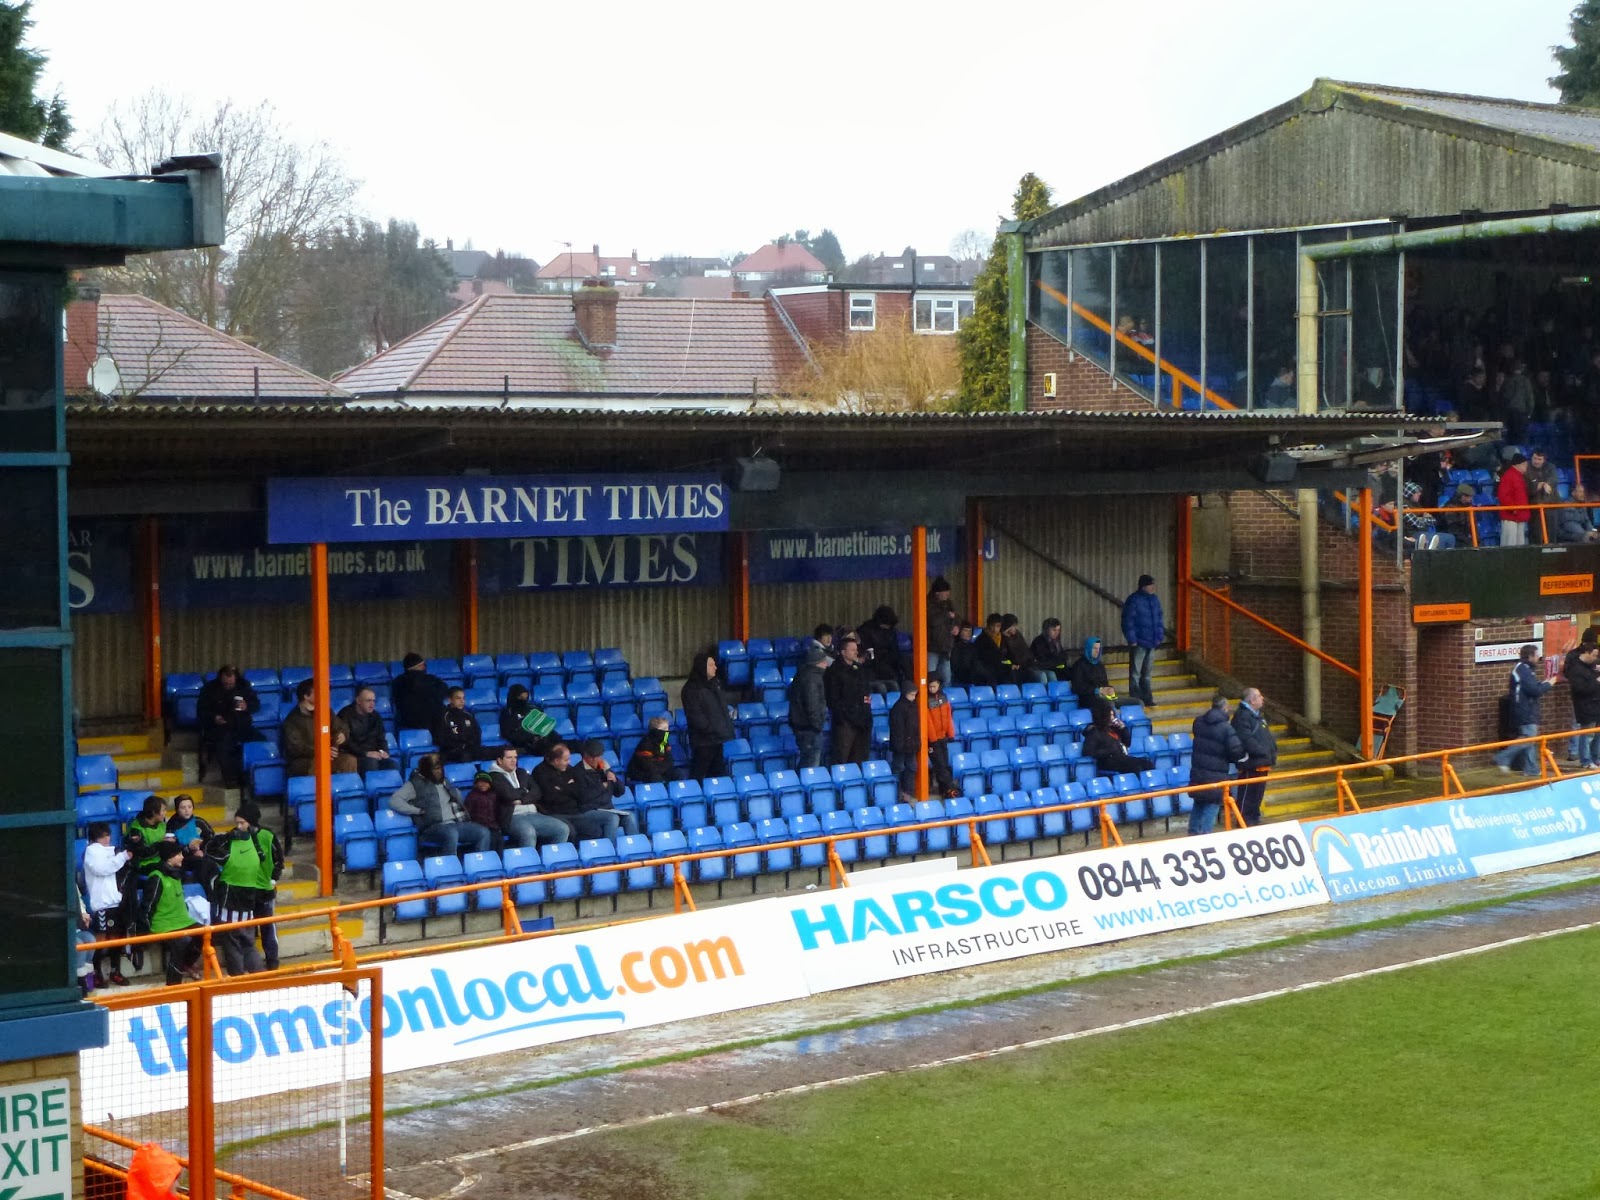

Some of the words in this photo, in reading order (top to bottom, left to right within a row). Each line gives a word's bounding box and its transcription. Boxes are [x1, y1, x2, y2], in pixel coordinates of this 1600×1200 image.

[346, 488, 411, 527] The
[425, 486, 592, 525] BARNET
[603, 483, 724, 521] TIMES
[193, 543, 426, 579] www.barnetmes.co.uk
[510, 533, 699, 588] TIMES
[769, 528, 941, 558] www.barnettimes.cuk
[1543, 579, 1591, 590] REFRESHMENTS
[1479, 648, 1496, 657] FIRST
[1497, 648, 1508, 656] AID
[1512, 825, 1531, 840] for
[1523, 805, 1556, 824] value
[1078, 855, 1161, 901] 0844
[1162, 846, 1226, 888] 335
[1232, 833, 1307, 876] 8860
[1351, 823, 1458, 869] Rainbow
[1329, 874, 1401, 897] Telecom
[1403, 857, 1467, 883] Limited
[791, 870, 1069, 950] HARSCO
[1093, 876, 1320, 931] www.harsco-i.co.uk
[892, 918, 1084, 966] INFRASTRUCTURE
[126, 935, 745, 1077] thomsonlocal.com
[0, 1088, 67, 1134] IRE
[0, 1134, 69, 1180] XIT
